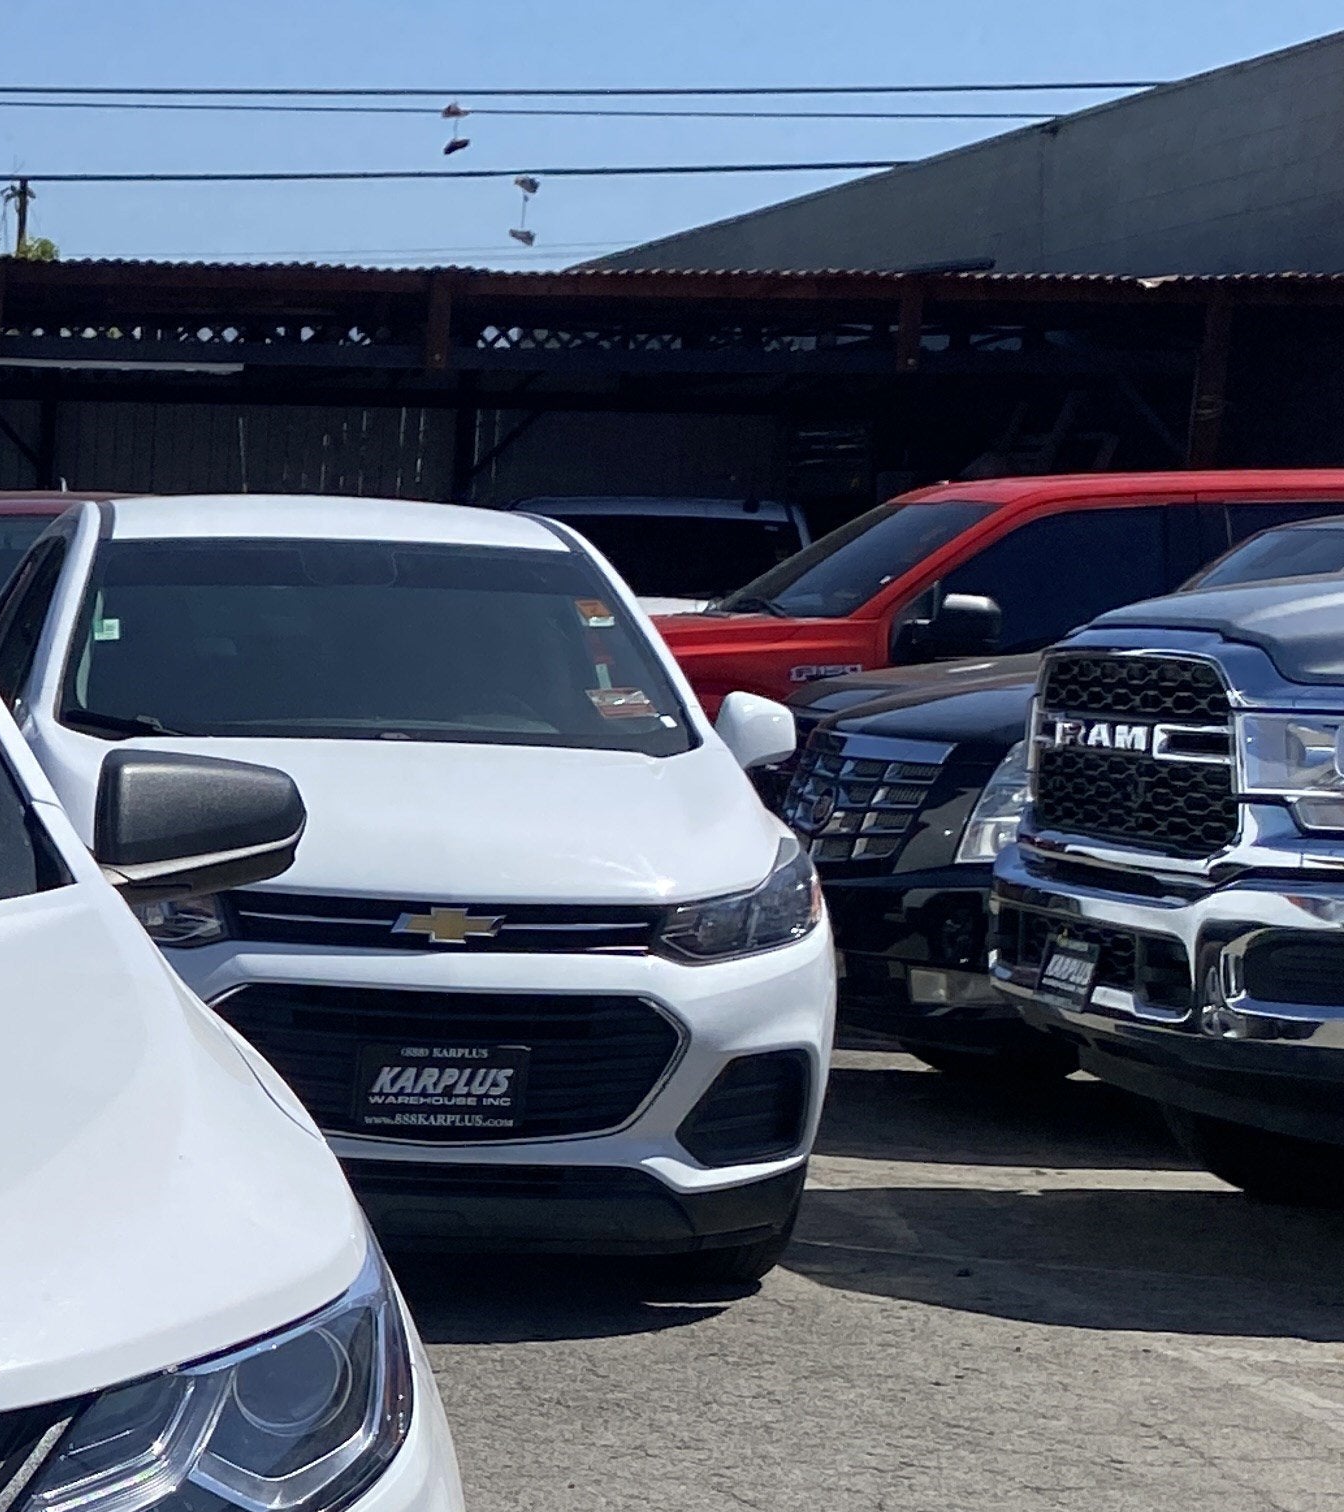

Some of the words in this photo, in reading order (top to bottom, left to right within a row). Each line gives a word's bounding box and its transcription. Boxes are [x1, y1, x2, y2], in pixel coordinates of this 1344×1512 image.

[1055, 721, 1148, 751] RAM
[432, 1048, 488, 1059] KARPLUS
[371, 1066, 514, 1095] KARPLUS
[368, 1096, 477, 1106] WAREHOUSE
[482, 1096, 511, 1106] INC
